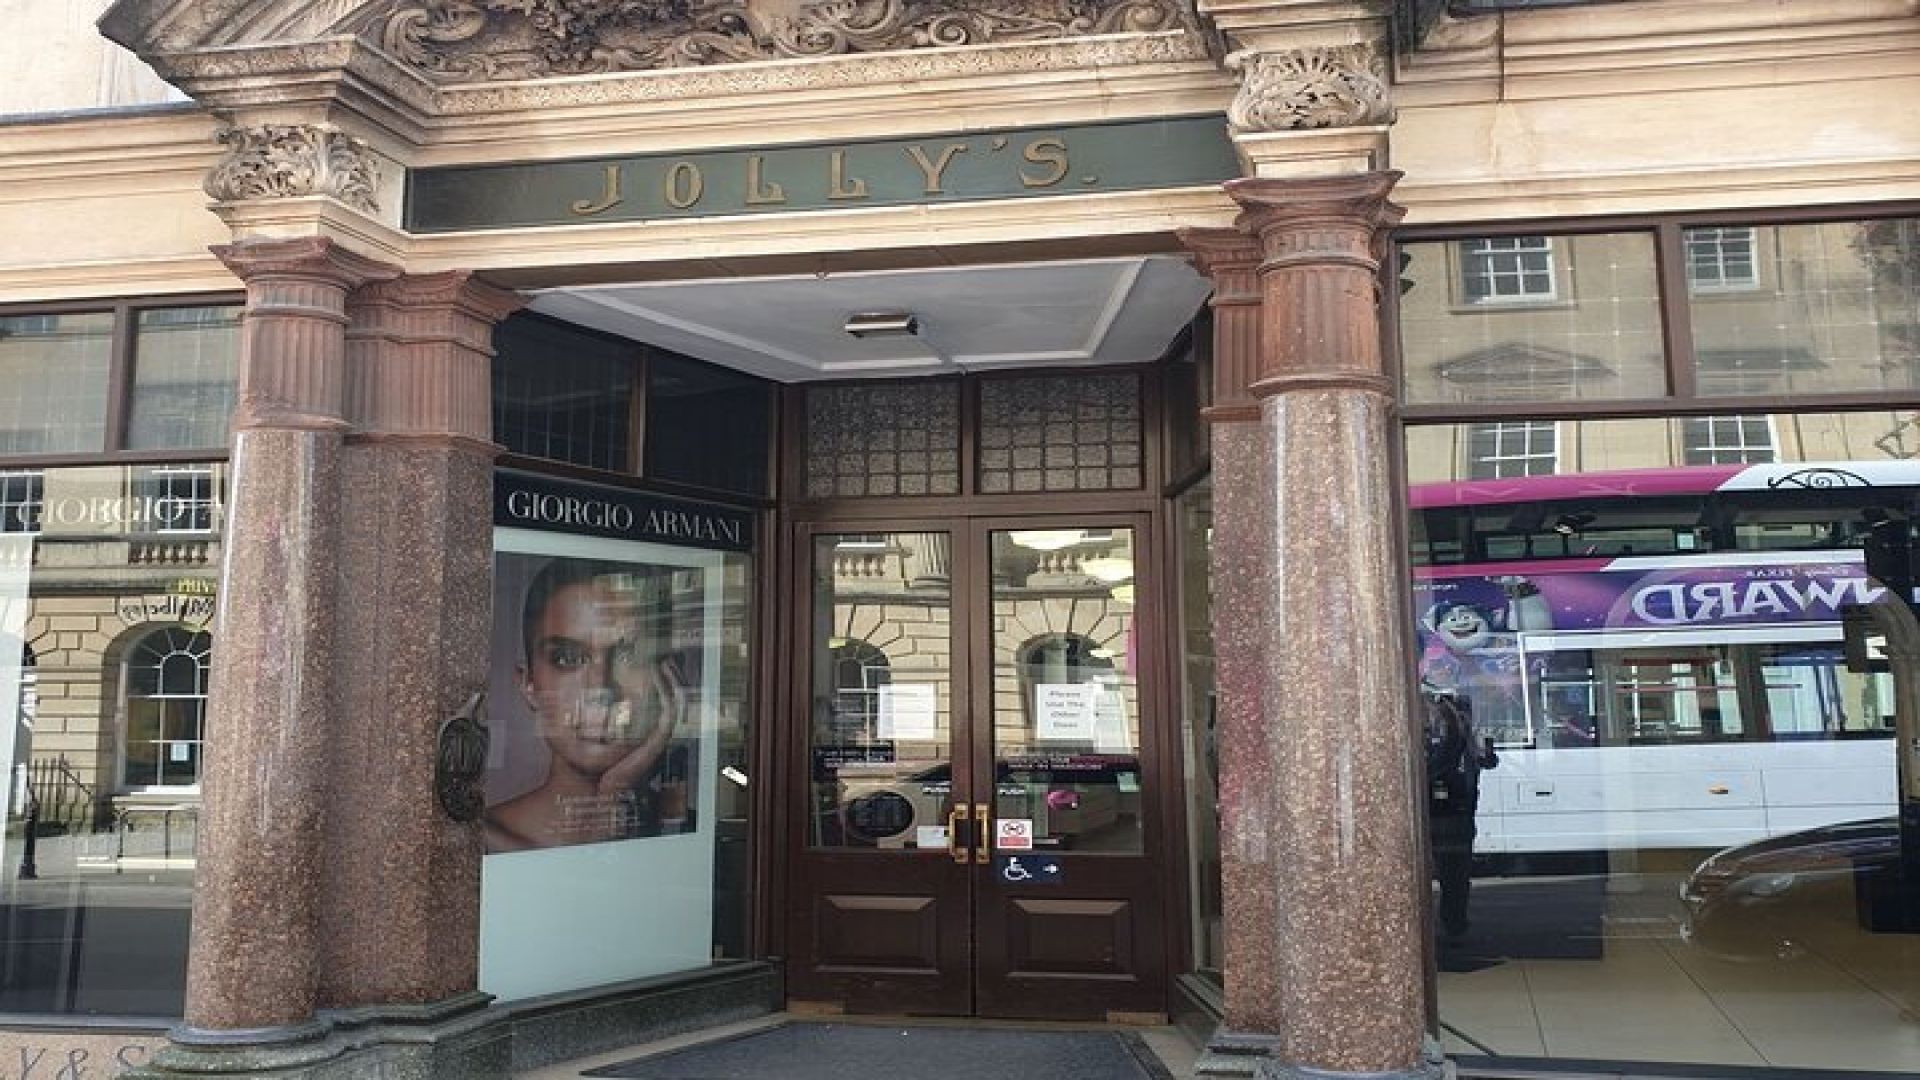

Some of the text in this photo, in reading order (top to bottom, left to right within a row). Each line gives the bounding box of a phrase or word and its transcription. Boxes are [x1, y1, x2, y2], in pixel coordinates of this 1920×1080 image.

[17, 496, 185, 524] GIORGIO
[508, 489, 742, 545] GIORGIO ARMANI
